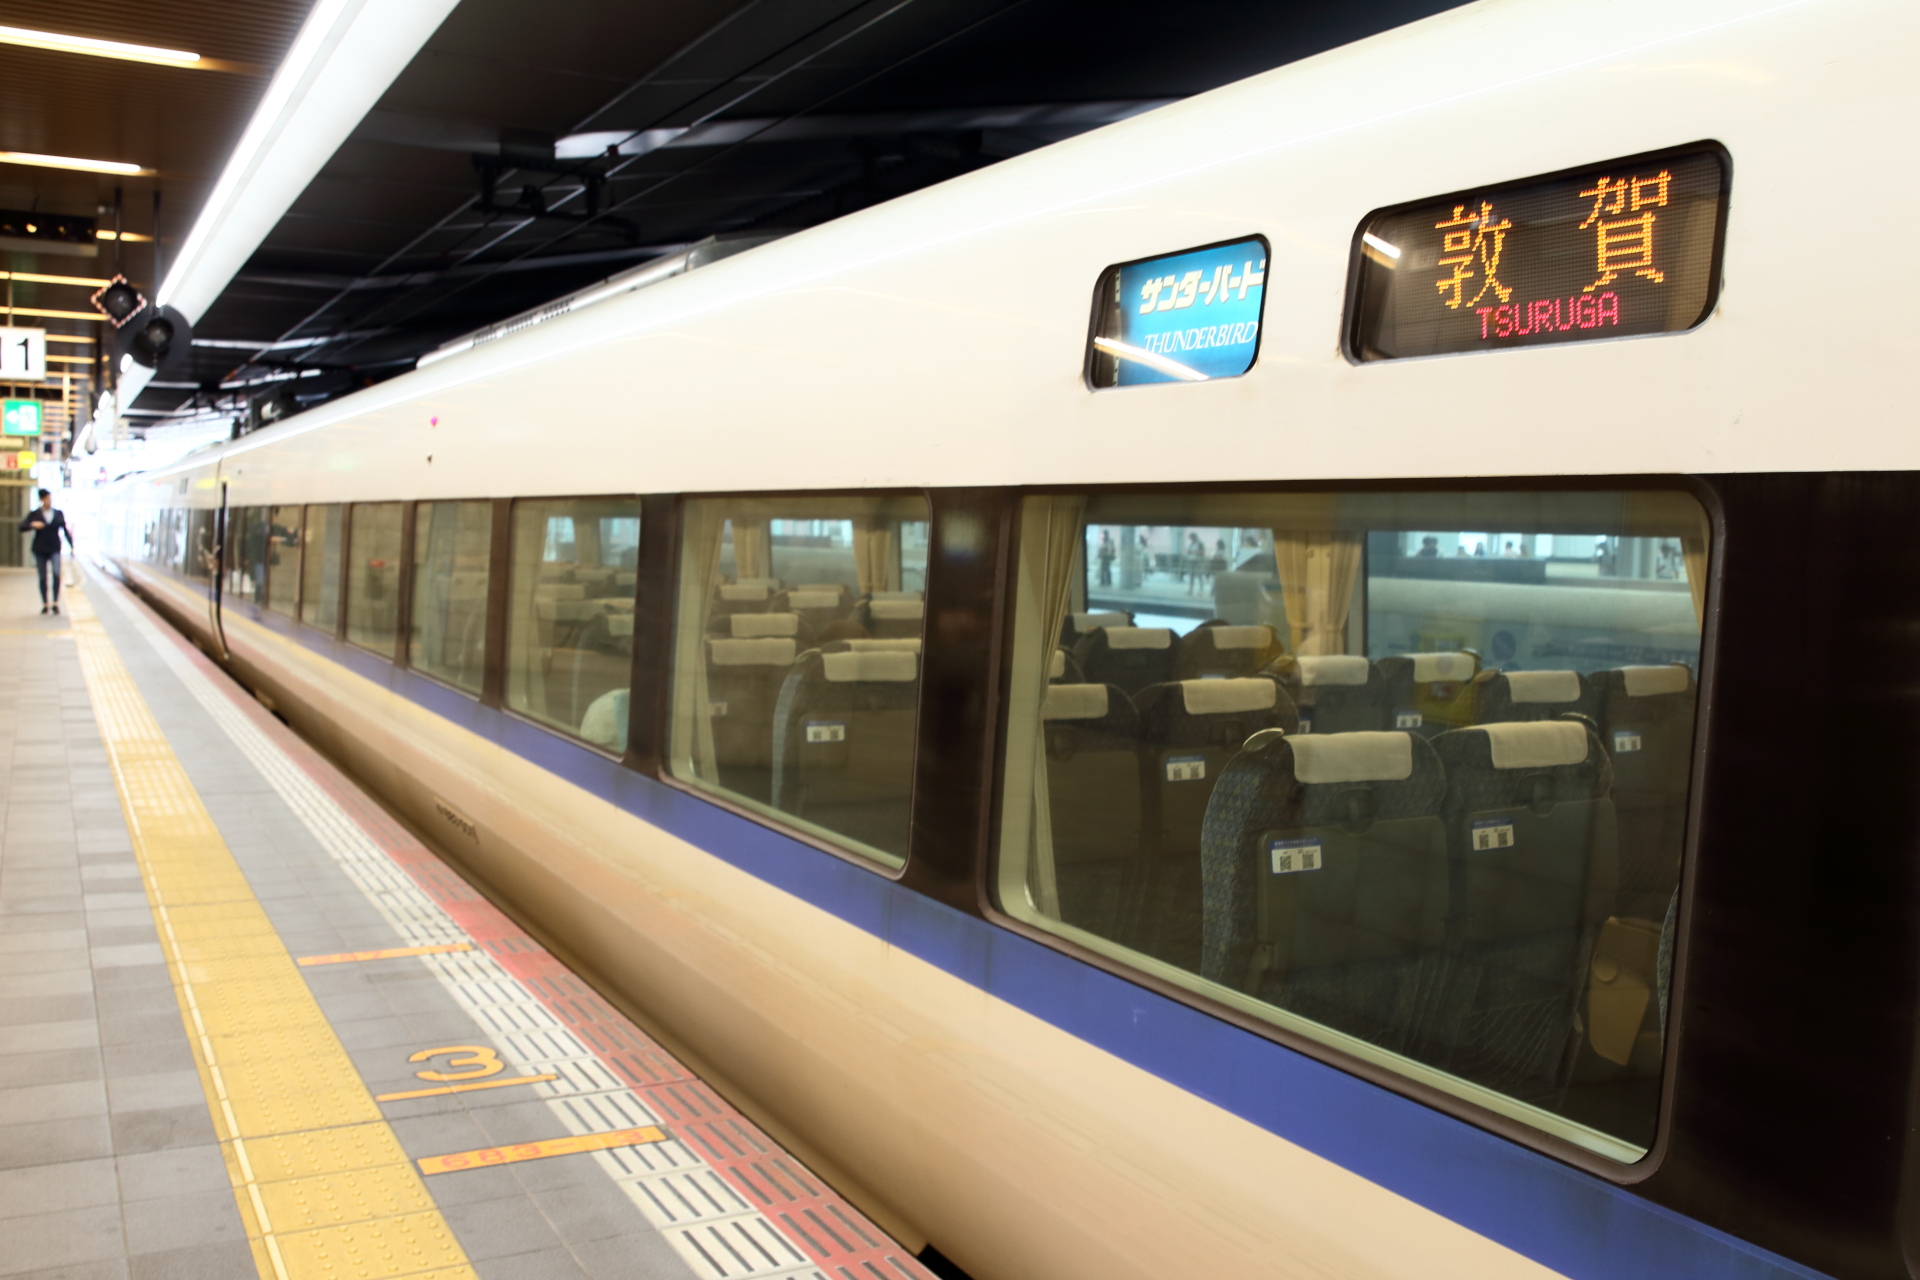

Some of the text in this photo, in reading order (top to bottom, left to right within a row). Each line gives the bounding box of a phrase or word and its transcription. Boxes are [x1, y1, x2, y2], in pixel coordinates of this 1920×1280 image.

[1435, 170, 1671, 309] 敦賀
[1139, 258, 1266, 315] サンダーバード
[1144, 320, 1259, 354] THUNDERBIRD
[1475, 291, 1619, 339] TSURUGA
[408, 1045, 505, 1082] 3
